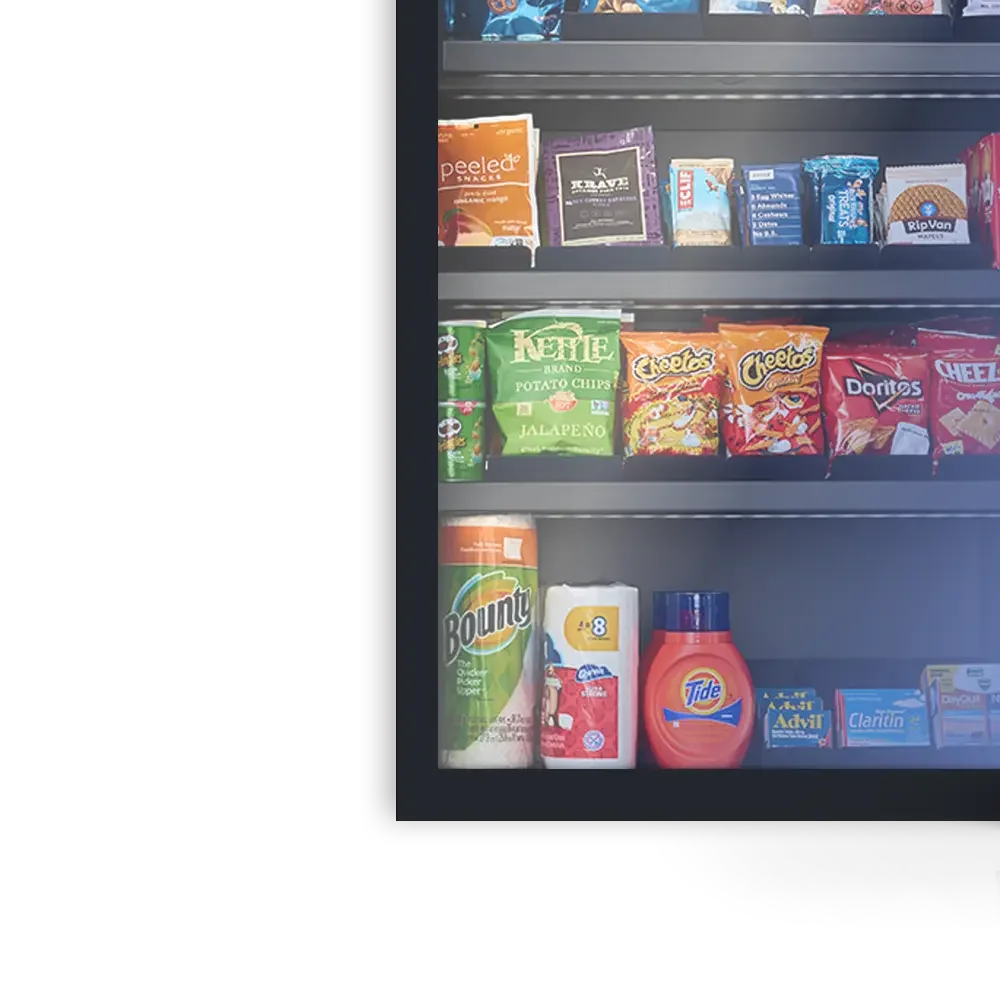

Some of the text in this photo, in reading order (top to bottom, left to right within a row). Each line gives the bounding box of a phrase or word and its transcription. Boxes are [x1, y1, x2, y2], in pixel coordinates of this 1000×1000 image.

[440, 152, 516, 182] peeled
[570, 176, 630, 191] KRAVE
[678, 170, 692, 200] CLIF
[837, 188, 850, 229] TREATS
[907, 219, 952, 233] Rip Van
[509, 322, 617, 364] KETTLE
[543, 364, 582, 374] BRAND
[635, 348, 714, 381] Cheetos
[741, 346, 816, 387] Cheetos
[515, 377, 612, 392] POTATO CHIPS
[845, 377, 923, 397] Doritos
[518, 422, 607, 439] JALAPEÑO
[443, 585, 532, 667] Bounty
[591, 615, 607, 637] 8
[683, 679, 723, 709] Tide
[772, 713, 825, 730] Advil
[848, 710, 904, 729] Claritin
